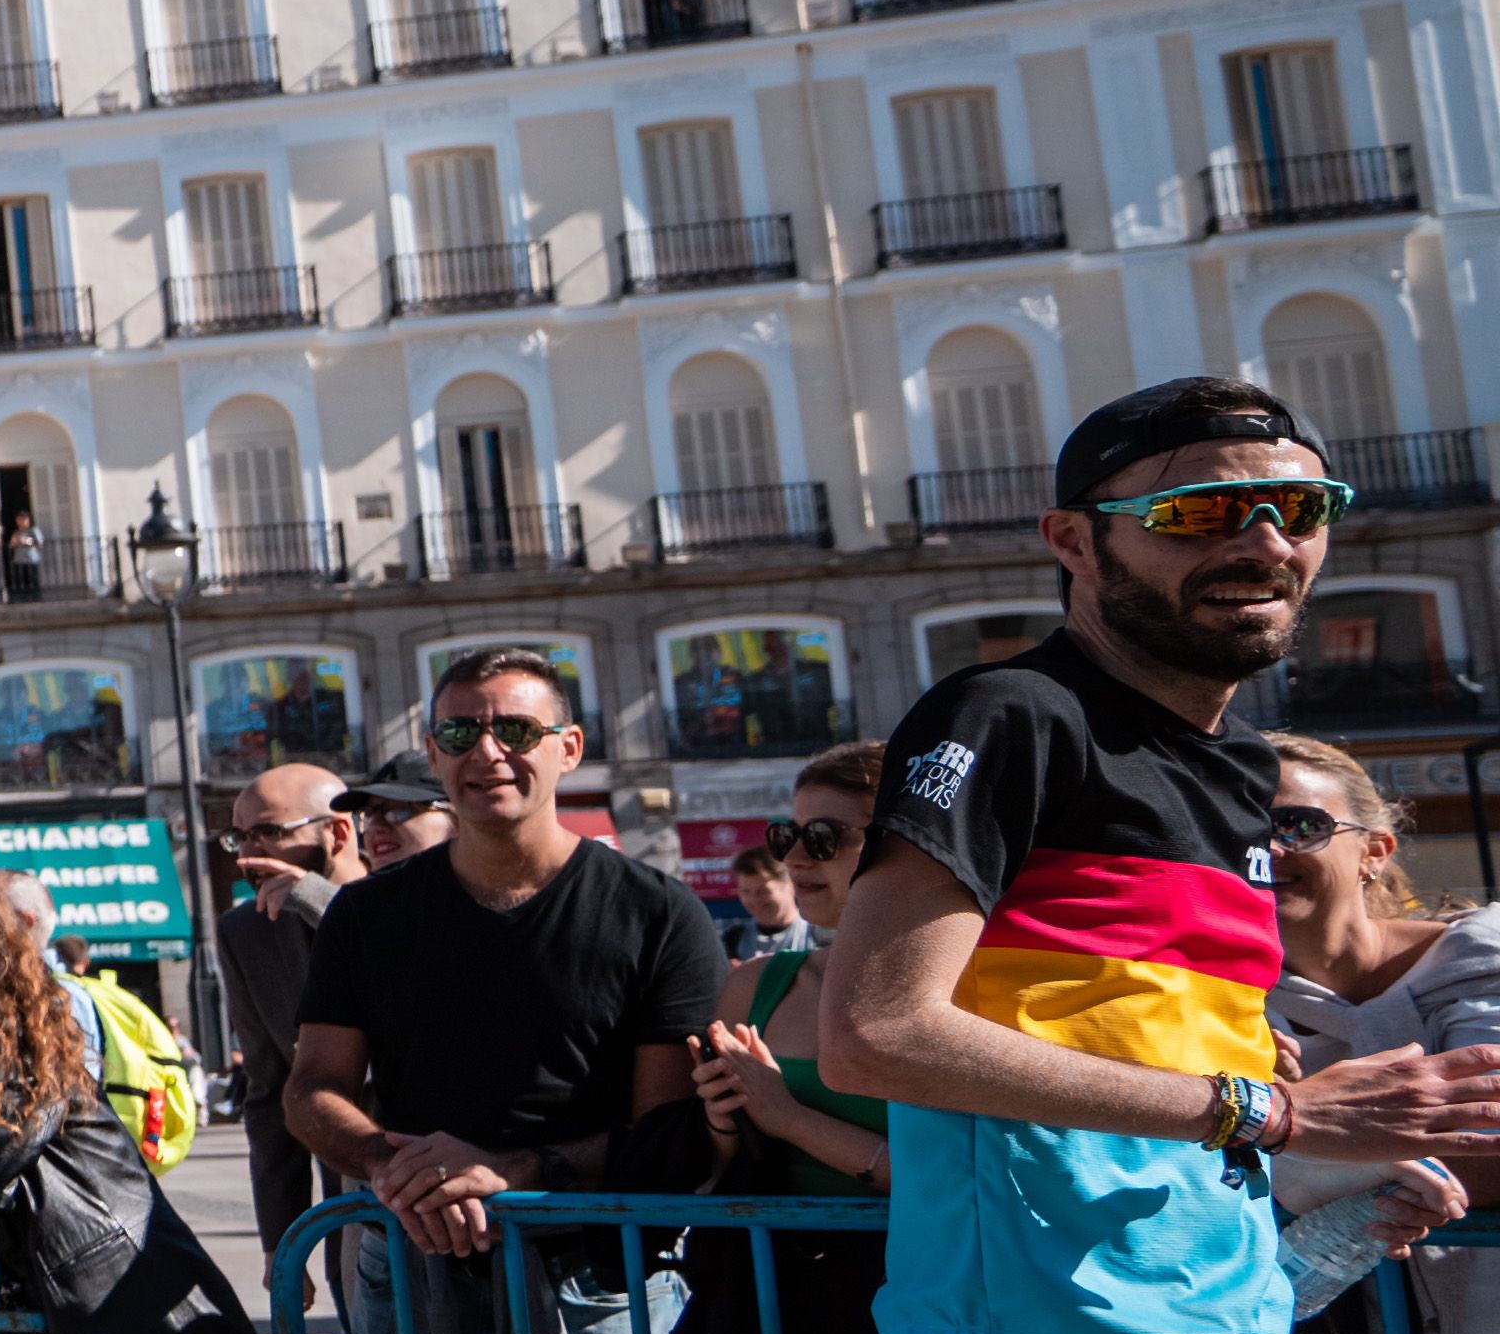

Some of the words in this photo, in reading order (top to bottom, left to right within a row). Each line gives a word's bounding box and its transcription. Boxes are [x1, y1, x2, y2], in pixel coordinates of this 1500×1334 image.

[901, 777, 955, 809] AMS
[27, 864, 160, 888] ANSFER
[53, 901, 170, 926] MBIO
[88, 943, 132, 958] ANGE
